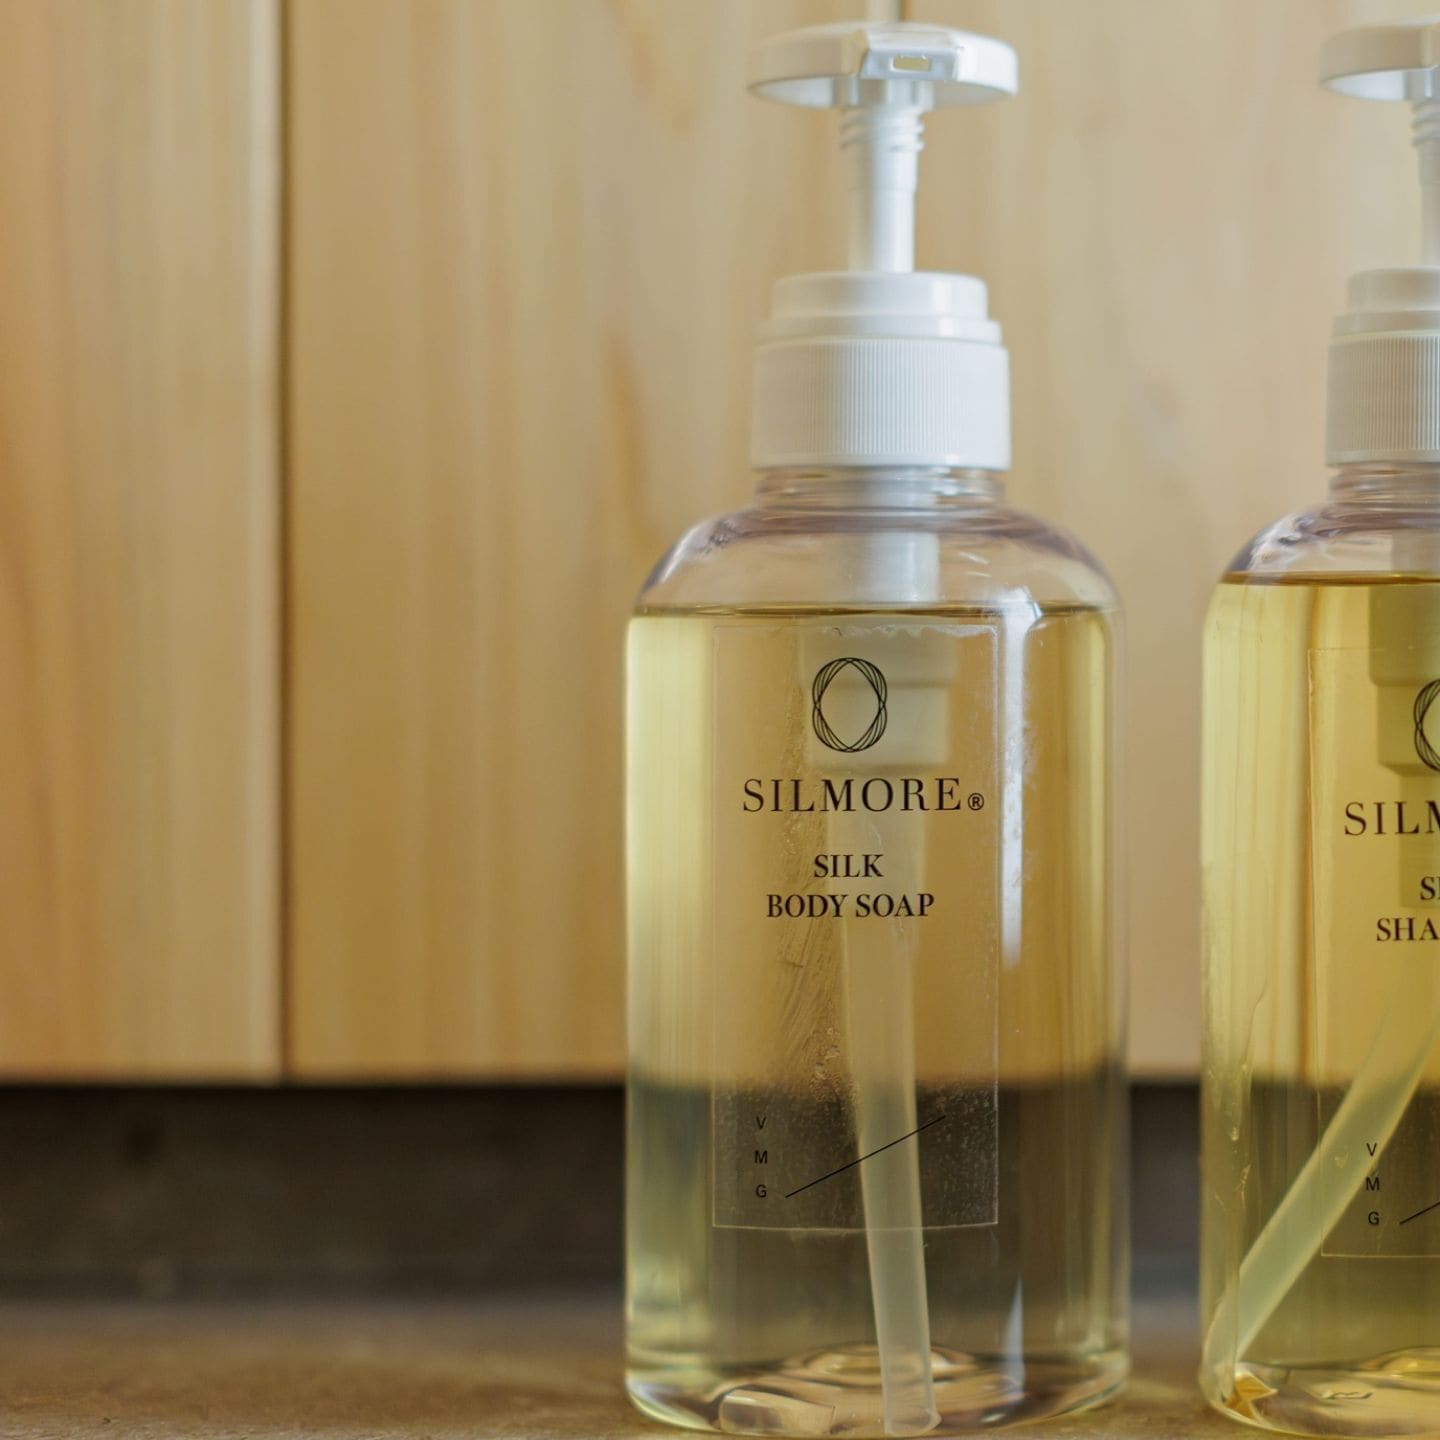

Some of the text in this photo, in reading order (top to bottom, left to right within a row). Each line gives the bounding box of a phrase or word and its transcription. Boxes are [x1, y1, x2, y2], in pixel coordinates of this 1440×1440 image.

[813, 853, 884, 879] SILK
[766, 893, 935, 918] BODY SOAP
[755, 1116, 767, 1131] V
[754, 1150, 768, 1164] M
[1366, 1142, 1378, 1157] V
[755, 1184, 767, 1199] G
[1365, 1177, 1380, 1191] M
[1367, 1211, 1380, 1226] G
